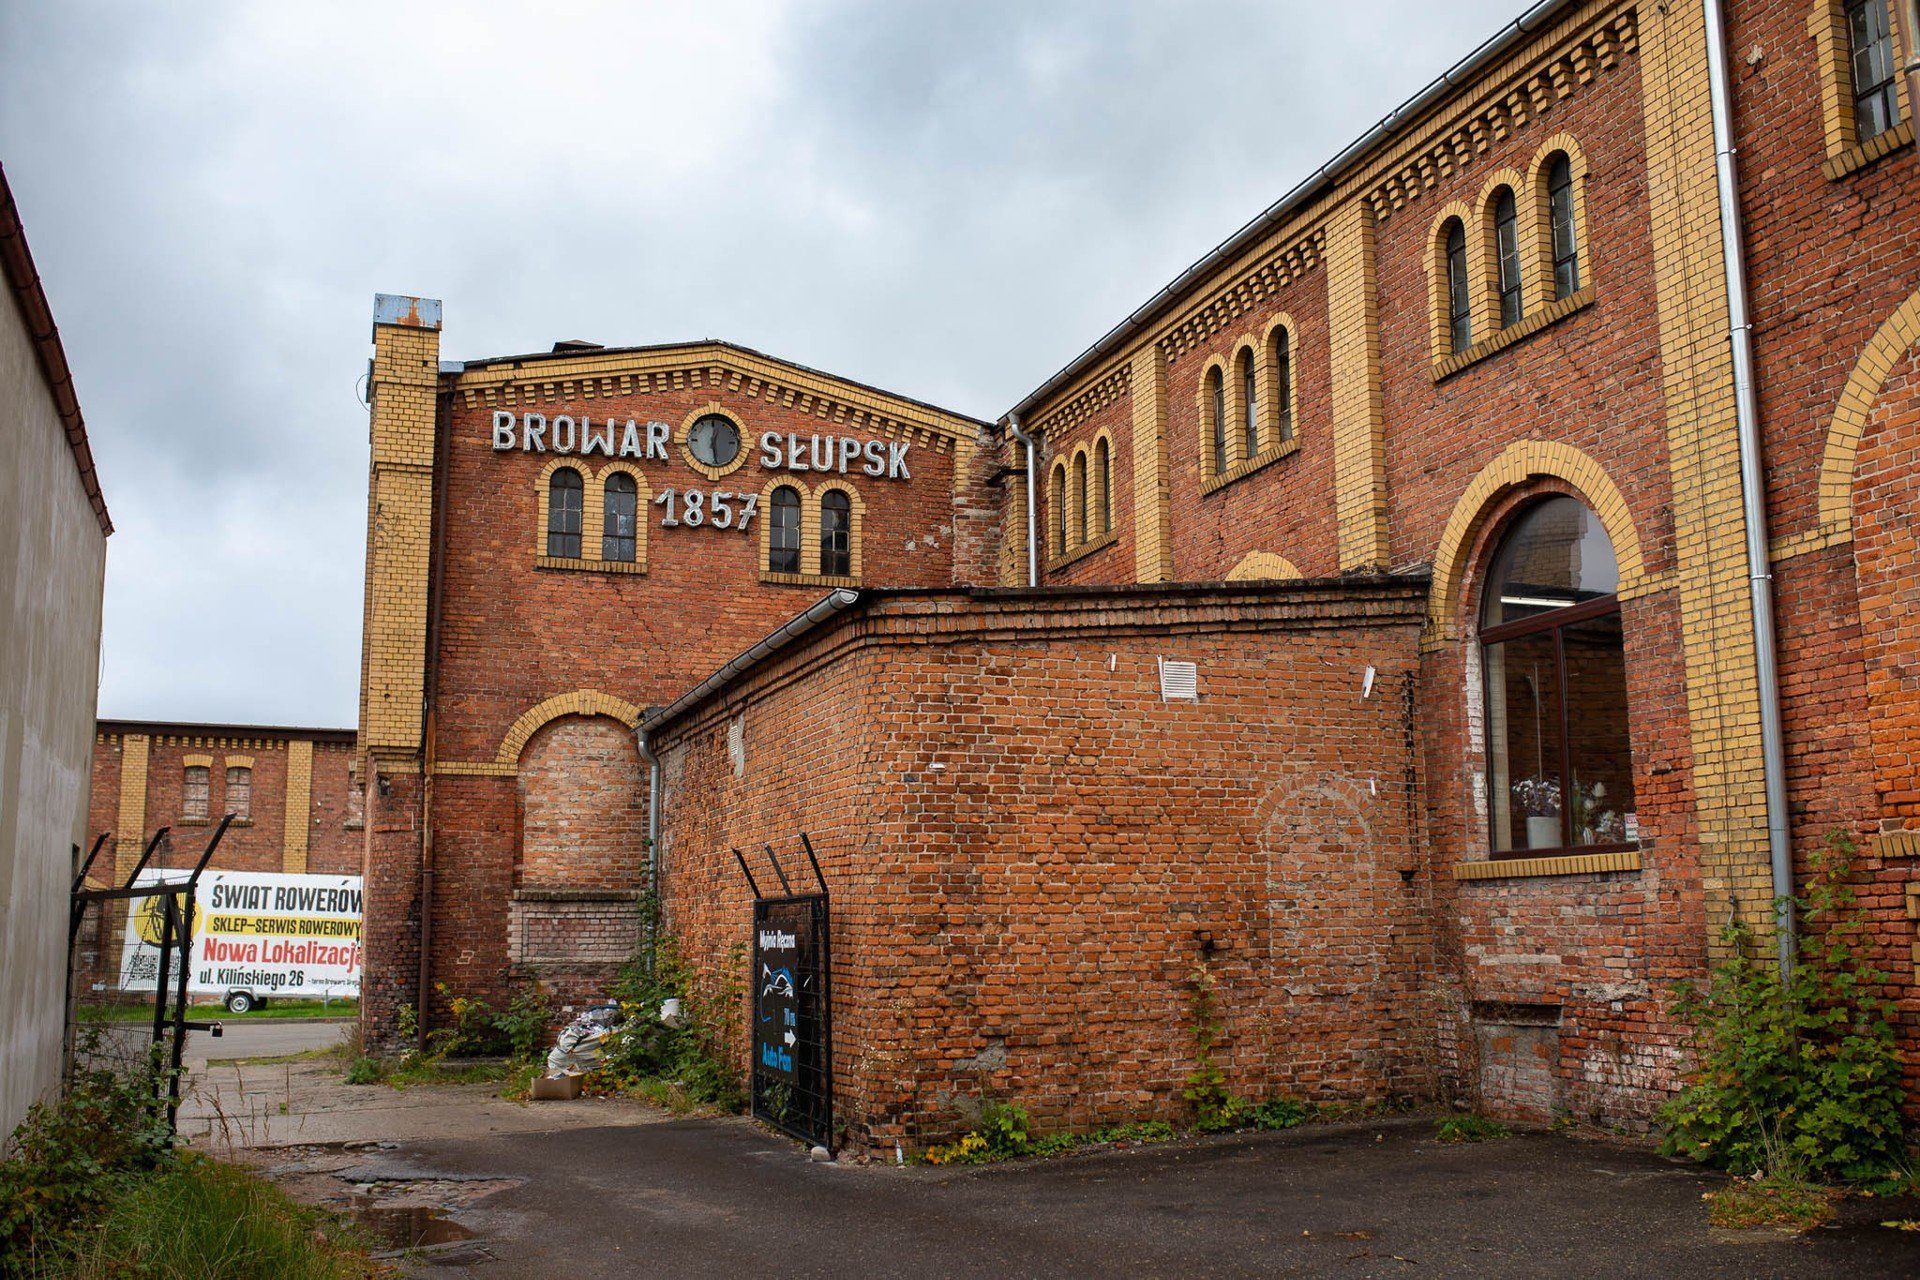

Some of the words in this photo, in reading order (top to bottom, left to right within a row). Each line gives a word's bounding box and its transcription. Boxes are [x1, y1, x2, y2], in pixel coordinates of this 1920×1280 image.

[492, 410, 670, 460] BROWAR
[760, 431, 911, 480] SŁUPSK
[654, 487, 759, 531] 1857
[211, 875, 272, 909] ŚWIAT
[299, 920, 362, 936] ROWEROWY
[203, 938, 258, 963] Nowa
[200, 969, 214, 985] ul.
[217, 966, 286, 991] Kilińskiego
[288, 970, 304, 987] 26
